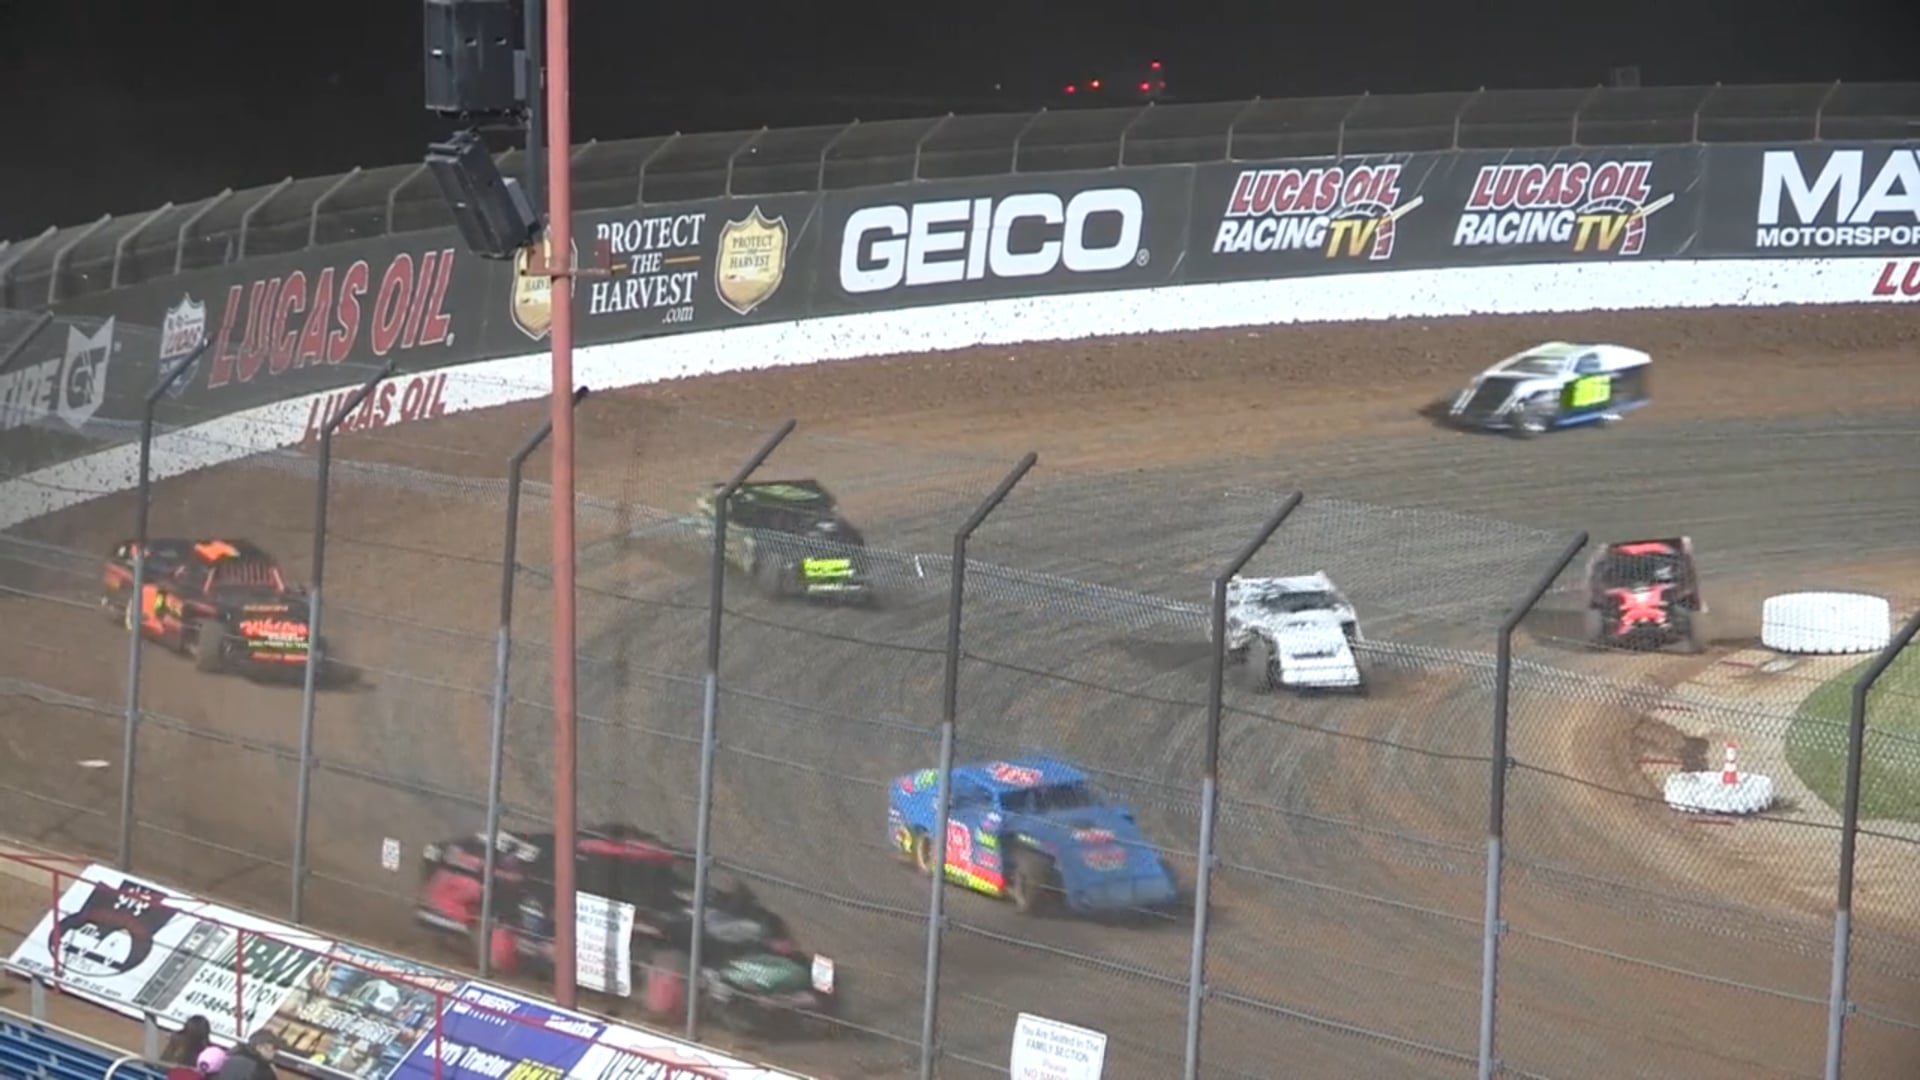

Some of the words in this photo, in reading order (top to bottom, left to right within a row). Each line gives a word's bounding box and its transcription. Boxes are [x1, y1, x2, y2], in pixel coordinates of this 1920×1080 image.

[1225, 167, 1344, 217] LUCAS
[1341, 164, 1402, 208] OIL
[1465, 161, 1592, 211] LUCAS
[1588, 161, 1652, 207] OIL
[1757, 150, 1920, 225] MA
[729, 255, 771, 269] HARVEST
[732, 234, 774, 249] PROTECT
[839, 188, 1143, 293] GEICO
[631, 253, 663, 275] THE
[590, 272, 698, 315] HARVEST
[662, 305, 694, 324] .com
[207, 260, 369, 389] LUCAS
[371, 249, 455, 356] OIL
[195, 968, 281, 1005] SANIATION
